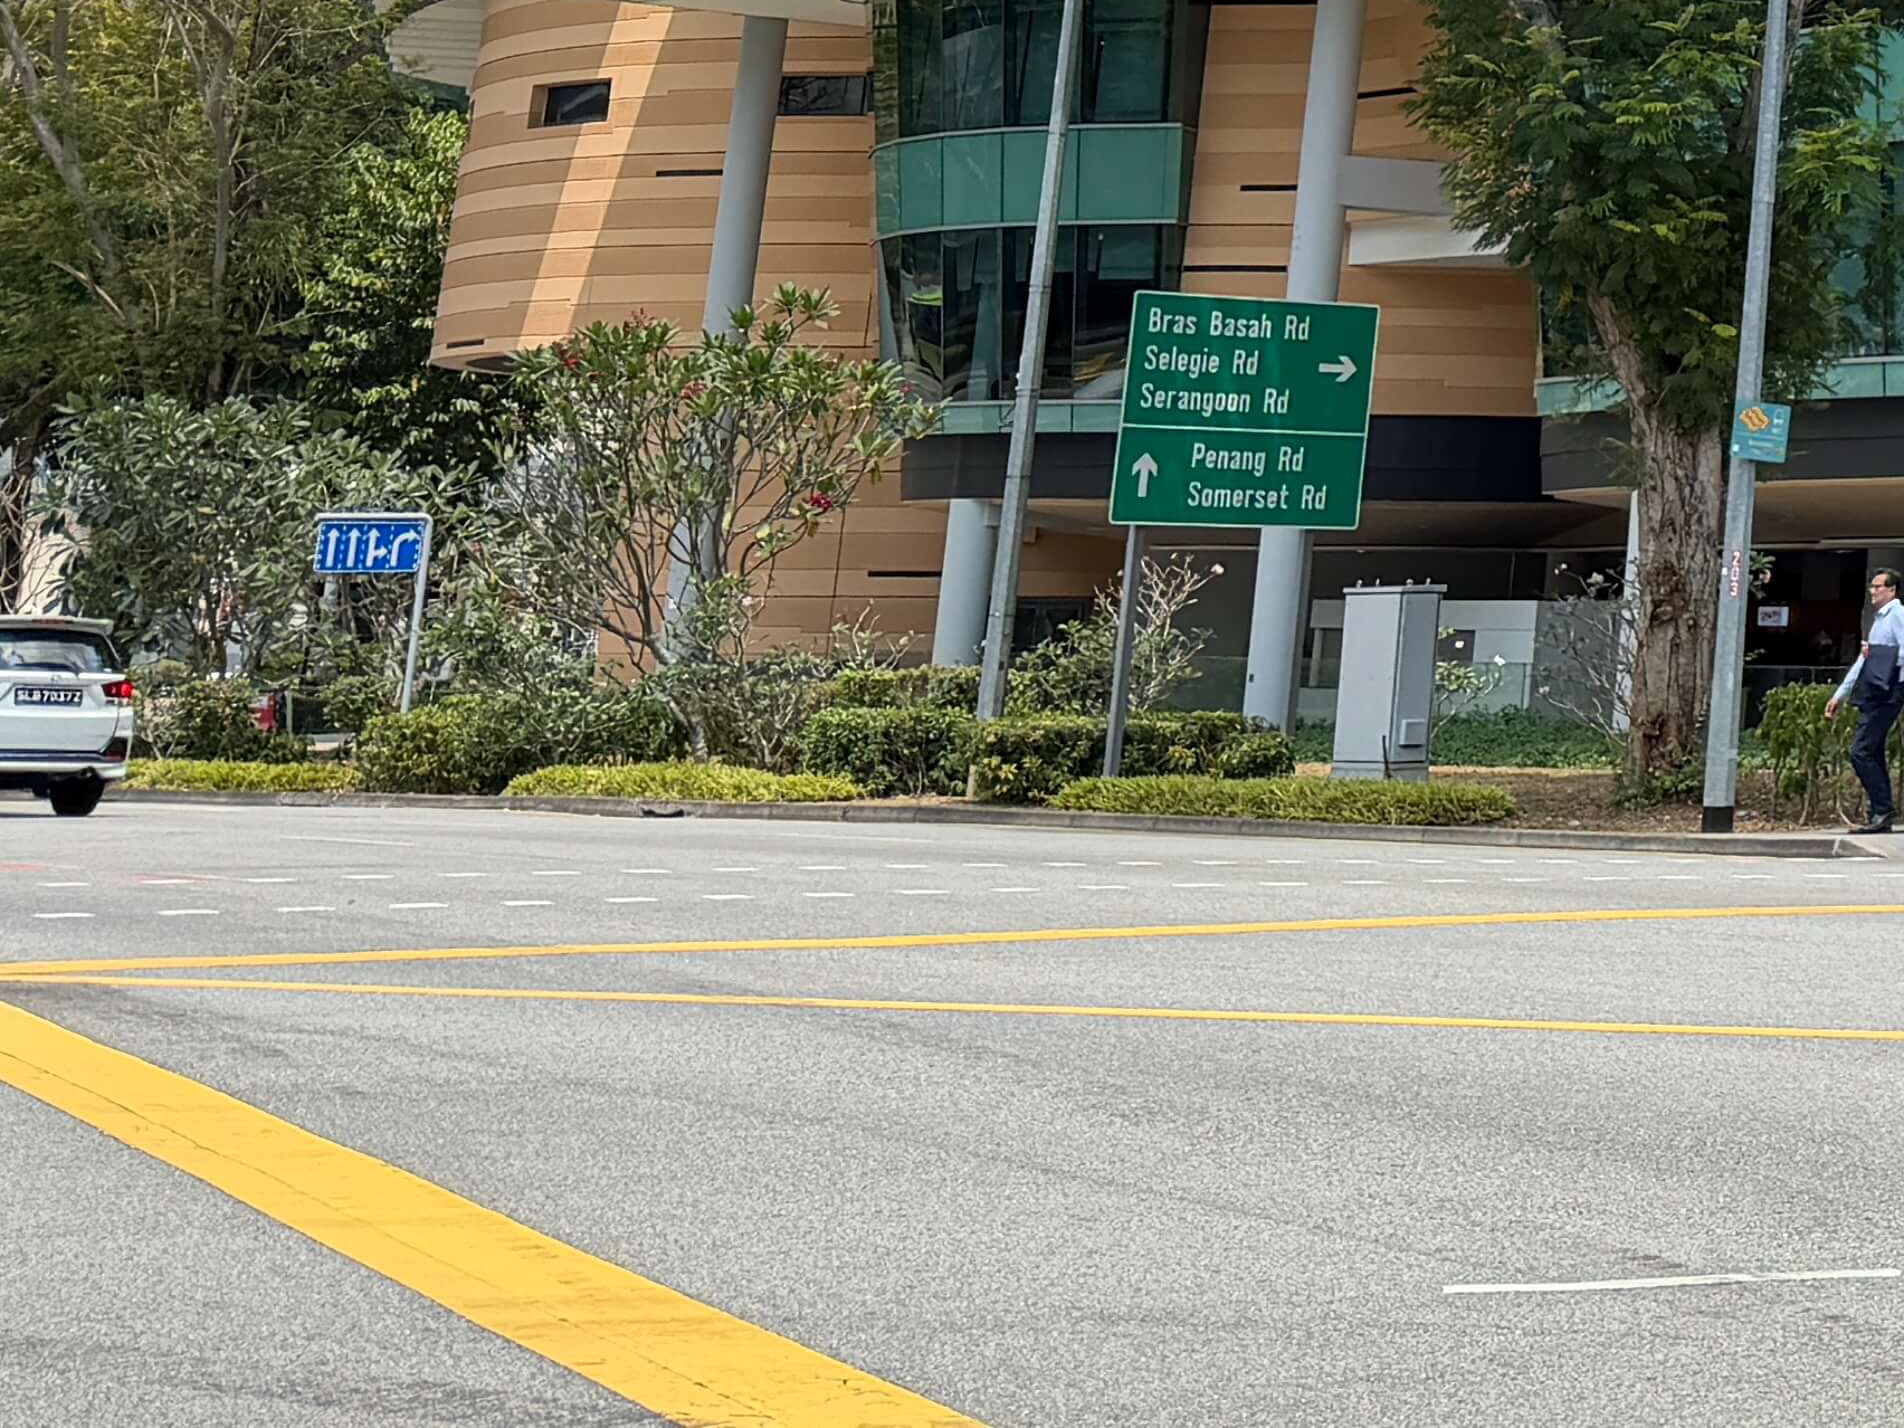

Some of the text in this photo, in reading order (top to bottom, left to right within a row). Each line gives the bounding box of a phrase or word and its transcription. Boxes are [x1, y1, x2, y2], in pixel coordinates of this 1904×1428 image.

[1148, 307, 1310, 341] Bras Basah Rd
[1144, 345, 1259, 379] Selegie Rd
[1140, 383, 1290, 417] Serangoon Rd
[1191, 443, 1305, 477] Penang Rd
[1187, 482, 1328, 511] Somerset Rd
[1730, 551, 1741, 597] 203
